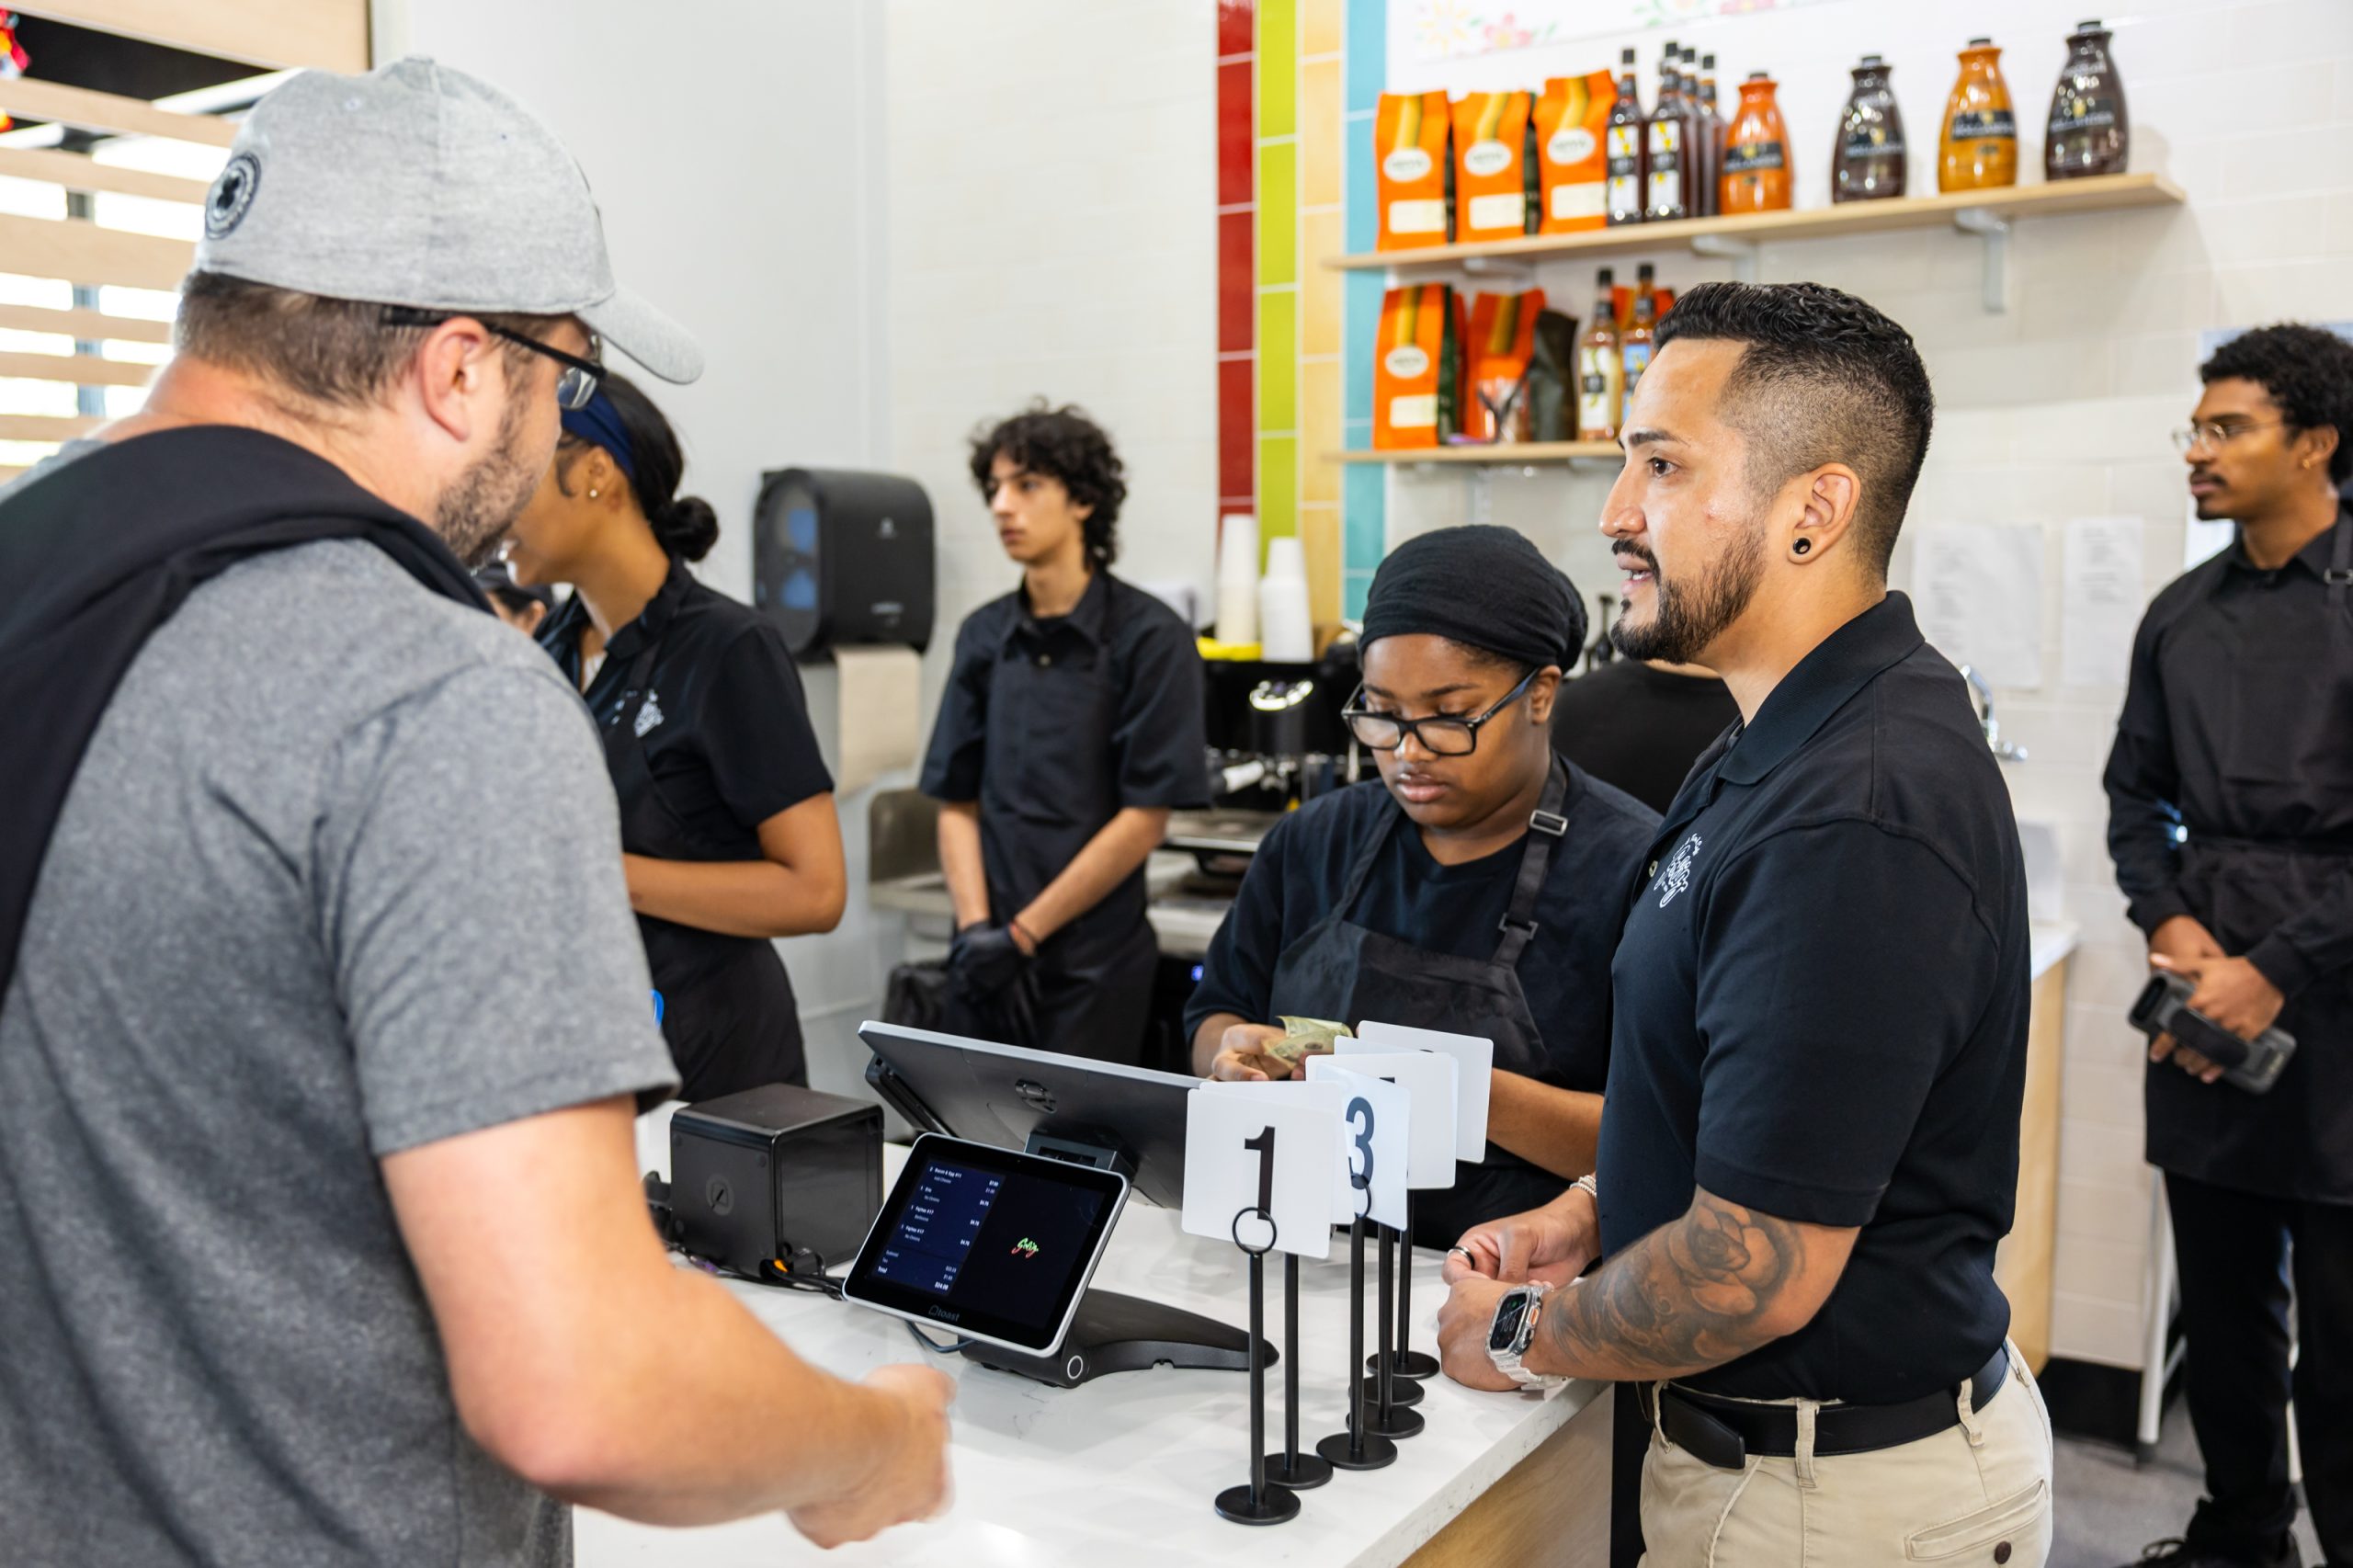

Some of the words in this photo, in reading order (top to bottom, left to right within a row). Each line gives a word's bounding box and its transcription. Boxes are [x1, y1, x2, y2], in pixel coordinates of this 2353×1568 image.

[1245, 1125, 1276, 1221] 1
[1345, 1096, 1375, 1190] 3
[938, 1308, 960, 1322] toast
